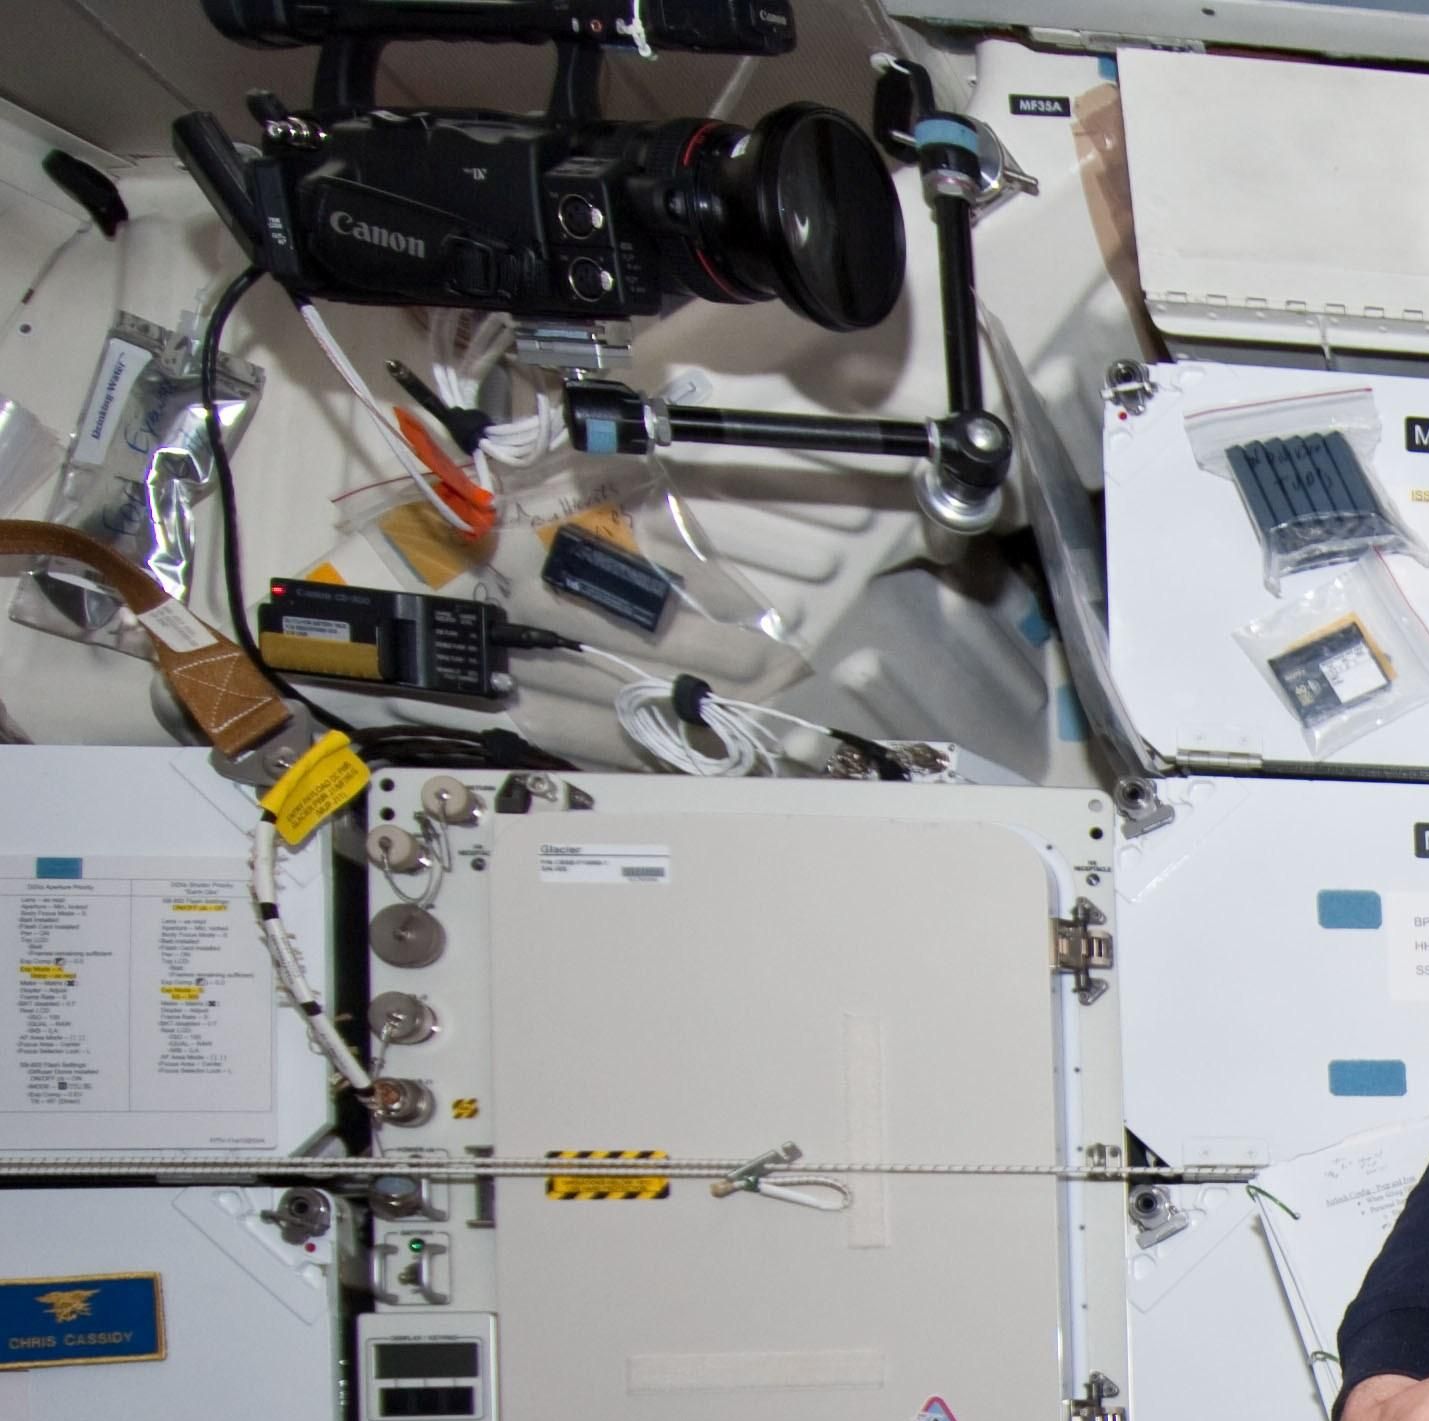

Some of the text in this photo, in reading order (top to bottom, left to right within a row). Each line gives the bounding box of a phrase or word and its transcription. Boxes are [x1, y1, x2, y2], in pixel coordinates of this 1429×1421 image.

[329, 209, 427, 261] Canon
[540, 844, 583, 855] Glacier
[8, 1331, 134, 1350] CHRIS CASSIDY
